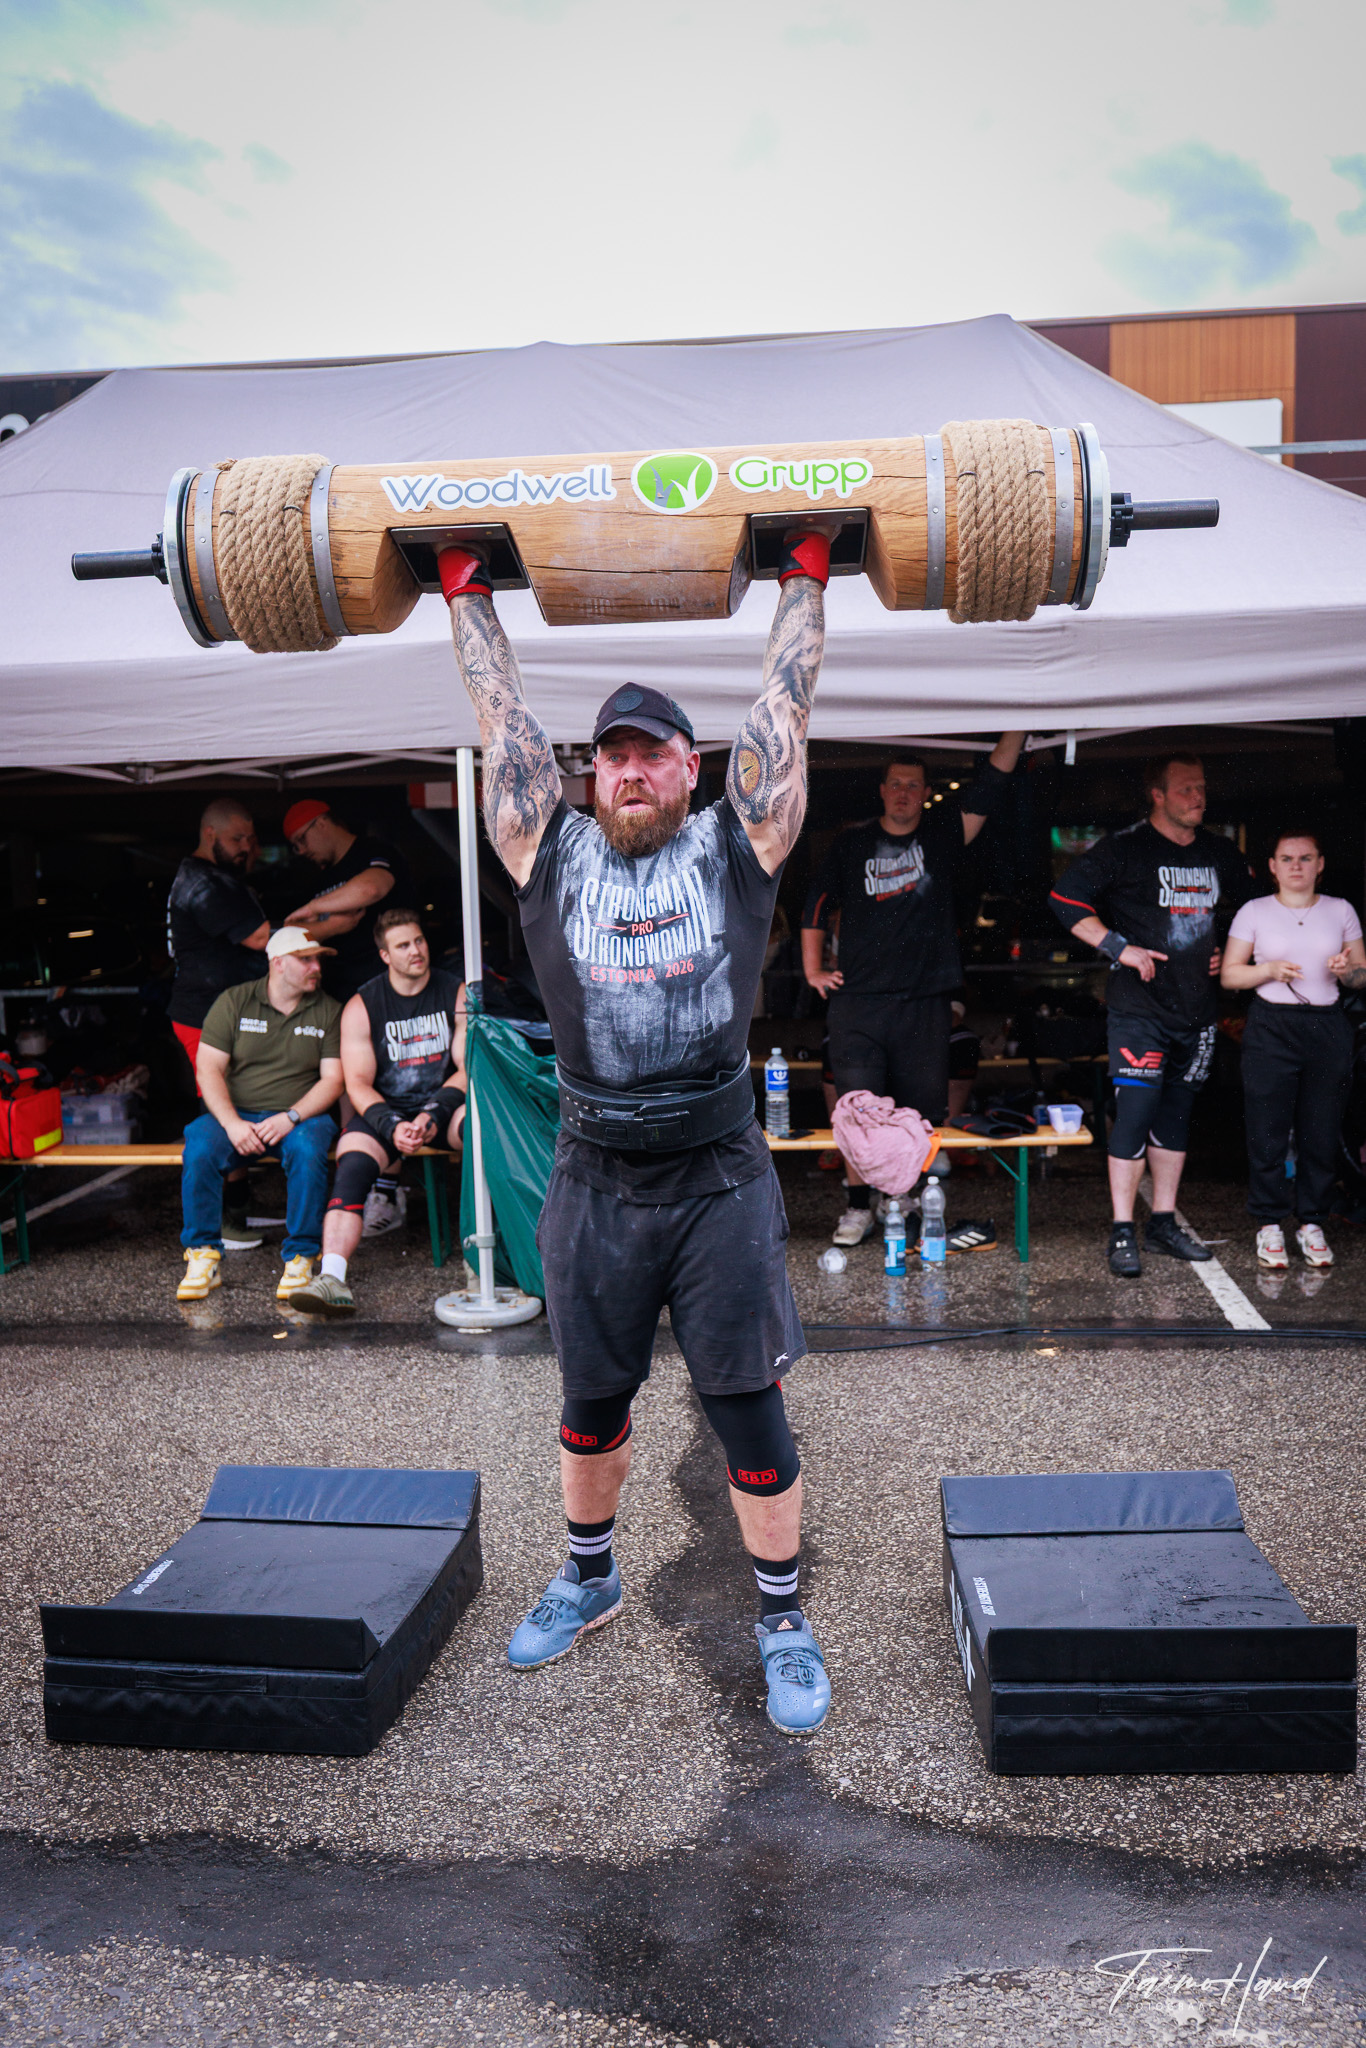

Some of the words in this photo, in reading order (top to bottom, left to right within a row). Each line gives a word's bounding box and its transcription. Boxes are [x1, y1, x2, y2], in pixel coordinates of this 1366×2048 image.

[387, 467, 612, 507] Woodwell
[735, 459, 868, 495] Grupp
[579, 866, 712, 923] STRONGMAN
[574, 912, 712, 967] STRONGWOMAN
[631, 920, 653, 936] PRO
[590, 965, 657, 984] ESTONIA
[665, 958, 694, 978] 2026
[561, 1426, 595, 1445] SBD
[739, 1471, 774, 1483] SBD
